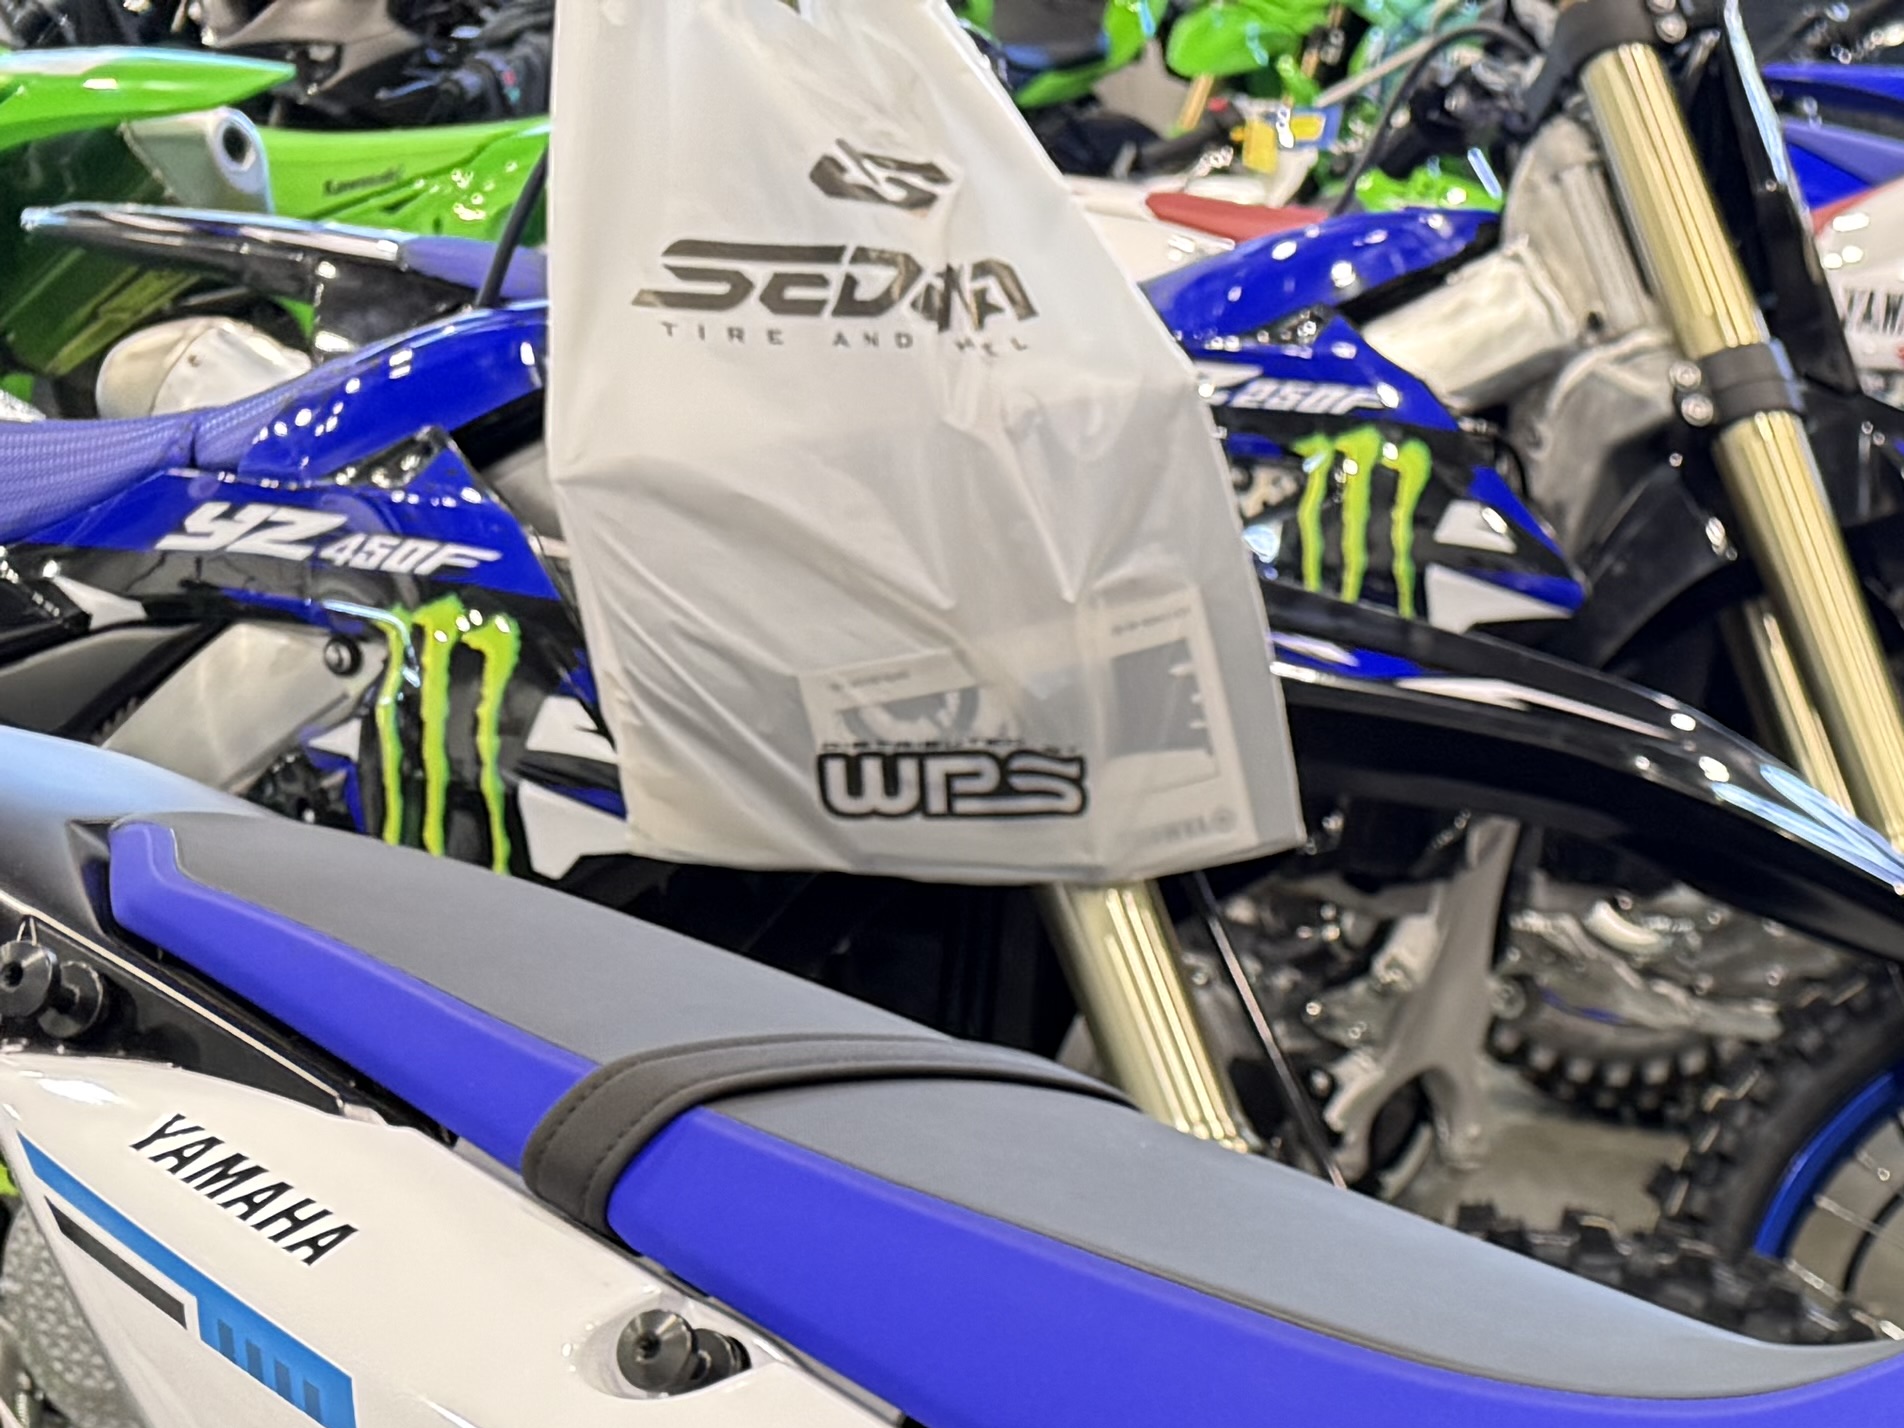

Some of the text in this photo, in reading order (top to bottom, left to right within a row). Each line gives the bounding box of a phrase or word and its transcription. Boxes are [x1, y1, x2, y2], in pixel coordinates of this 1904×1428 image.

[661, 321, 785, 346] TIRE
[832, 331, 914, 349] AND
[818, 750, 1087, 818] WPS
[128, 1114, 359, 1266] YAMAHA
